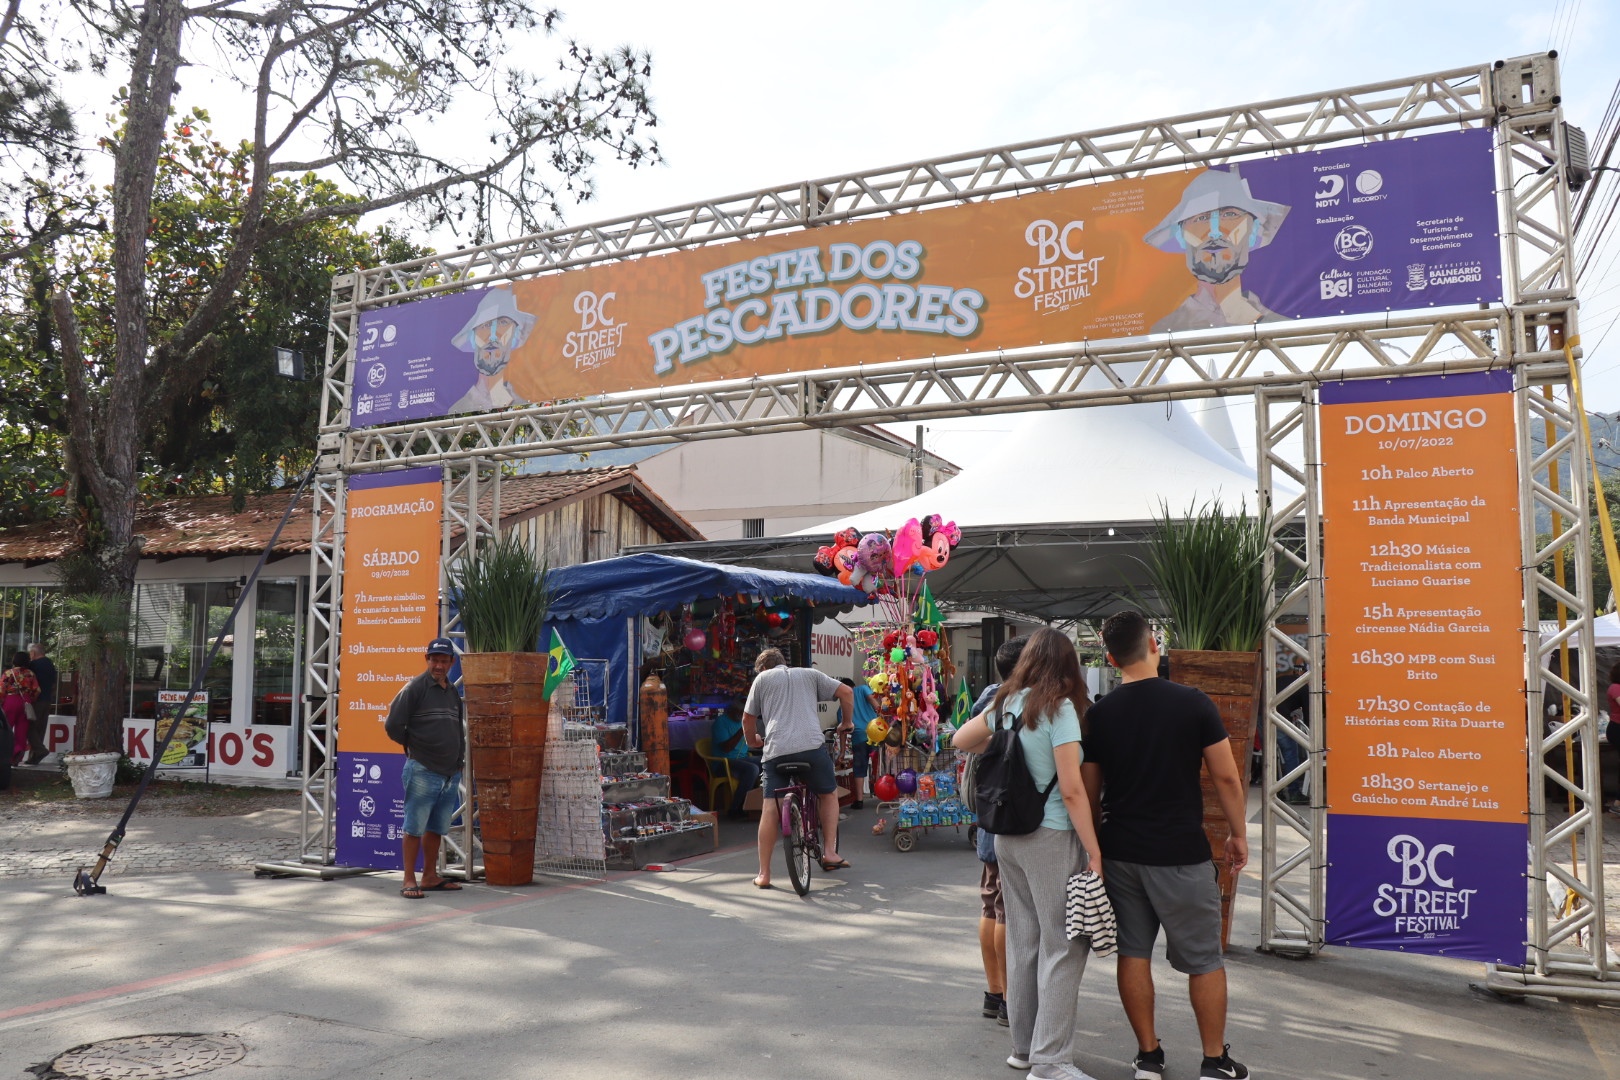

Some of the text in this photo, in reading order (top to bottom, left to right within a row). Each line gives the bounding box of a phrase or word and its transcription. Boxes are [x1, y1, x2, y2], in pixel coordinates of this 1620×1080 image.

[1313, 163, 1350, 172] Patrocínio
[1315, 199, 1340, 208] NDTV
[1316, 214, 1354, 224] Realização
[1416, 217, 1453, 226] Secretaria
[1423, 226, 1452, 234] Turismo
[1025, 219, 1084, 265] BC
[1341, 232, 1366, 249] BC
[1410, 232, 1473, 244] Desenvolvimento
[1422, 242, 1461, 251] Econômico
[701, 240, 922, 307] FESTA DOS
[1014, 256, 1104, 298] STREET
[1320, 268, 1352, 280] Cultura
[1357, 268, 1392, 276] FUNDAÇÃO
[1429, 266, 1481, 278] BALNEÁRIO
[1430, 272, 1482, 285] CAMBORIÚ
[1358, 281, 1392, 289] BALNEÁRIO
[1358, 287, 1391, 295] CAMBORIÚ
[1034, 284, 1091, 311] FESTIVAL
[574, 291, 616, 330] BC
[648, 283, 984, 374] PESCADORES
[562, 322, 628, 358] STREET
[575, 346, 616, 368] FESTIVAL
[1344, 408, 1487, 435] DOMINGO
[1378, 437, 1453, 451] 10/07/2022
[1361, 465, 1474, 480] 10h Palco Aberto
[351, 498, 435, 518] PROGRAMAÇÃO
[1353, 496, 1486, 512] 11h Apresentação da
[1368, 512, 1470, 526] Banda Municipal
[1370, 541, 1471, 558] 12h30 Música
[363, 548, 420, 567] SÁBADO
[1360, 560, 1452, 572] Tradicionalista
[371, 570, 410, 578] 09/07/2022
[1371, 576, 1471, 587] Luciano Guarise
[355, 591, 366, 604] 7h
[394, 592, 426, 601] simbólico
[354, 606, 361, 614] de
[362, 606, 390, 614] camarão
[1363, 602, 1482, 620] 15h Apresentação
[357, 615, 422, 625] Balneário Camboriú
[1355, 622, 1490, 633] circense Nádia Garcia
[348, 642, 365, 655] 19h
[397, 645, 405, 653] do
[1352, 649, 1496, 666] 16h30 MPB com Susi
[357, 670, 375, 682] 20h
[376, 674, 394, 682] Palco
[1407, 670, 1438, 680] Brito
[349, 699, 366, 710] 21h
[1358, 696, 1491, 714] 17h30 Contação de
[1344, 716, 1505, 729] Histórias com Rita Duarte
[1367, 742, 1482, 760] 18h Palco Aberto
[1361, 773, 1414, 791] 18h30
[1418, 780, 1478, 794] Sertanejo
[1352, 793, 1499, 809] Gaúcho com André Luis
[1387, 834, 1455, 888] BC
[1373, 883, 1477, 919] STREET
[1395, 916, 1460, 933] FESTIVAL
